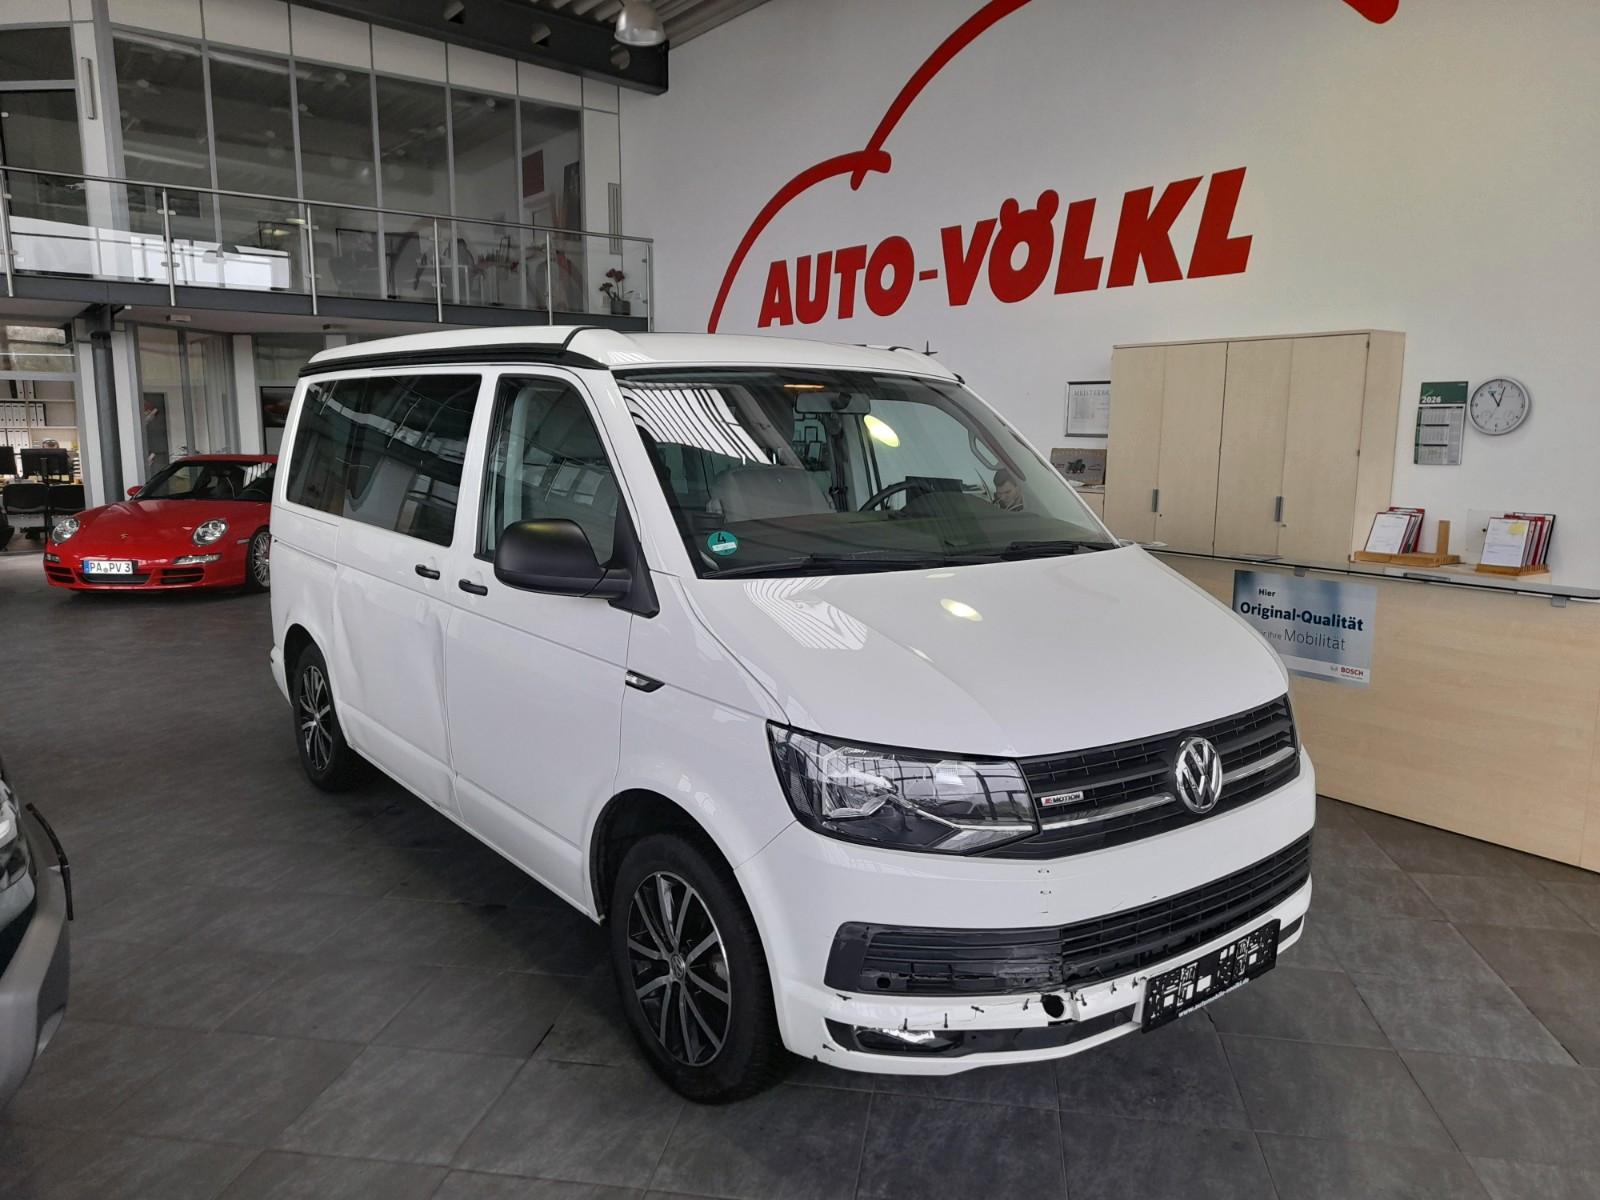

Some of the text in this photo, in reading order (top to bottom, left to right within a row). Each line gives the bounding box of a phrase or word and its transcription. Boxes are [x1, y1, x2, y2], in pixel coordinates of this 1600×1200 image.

[757, 167, 1253, 328] AUTO-VÖLKL
[90, 562, 131, 573] PA PV 3
[1258, 588, 1276, 598] Hier
[1240, 601, 1364, 632] Original-Qualität
[1340, 666, 1364, 677] BOSCH
